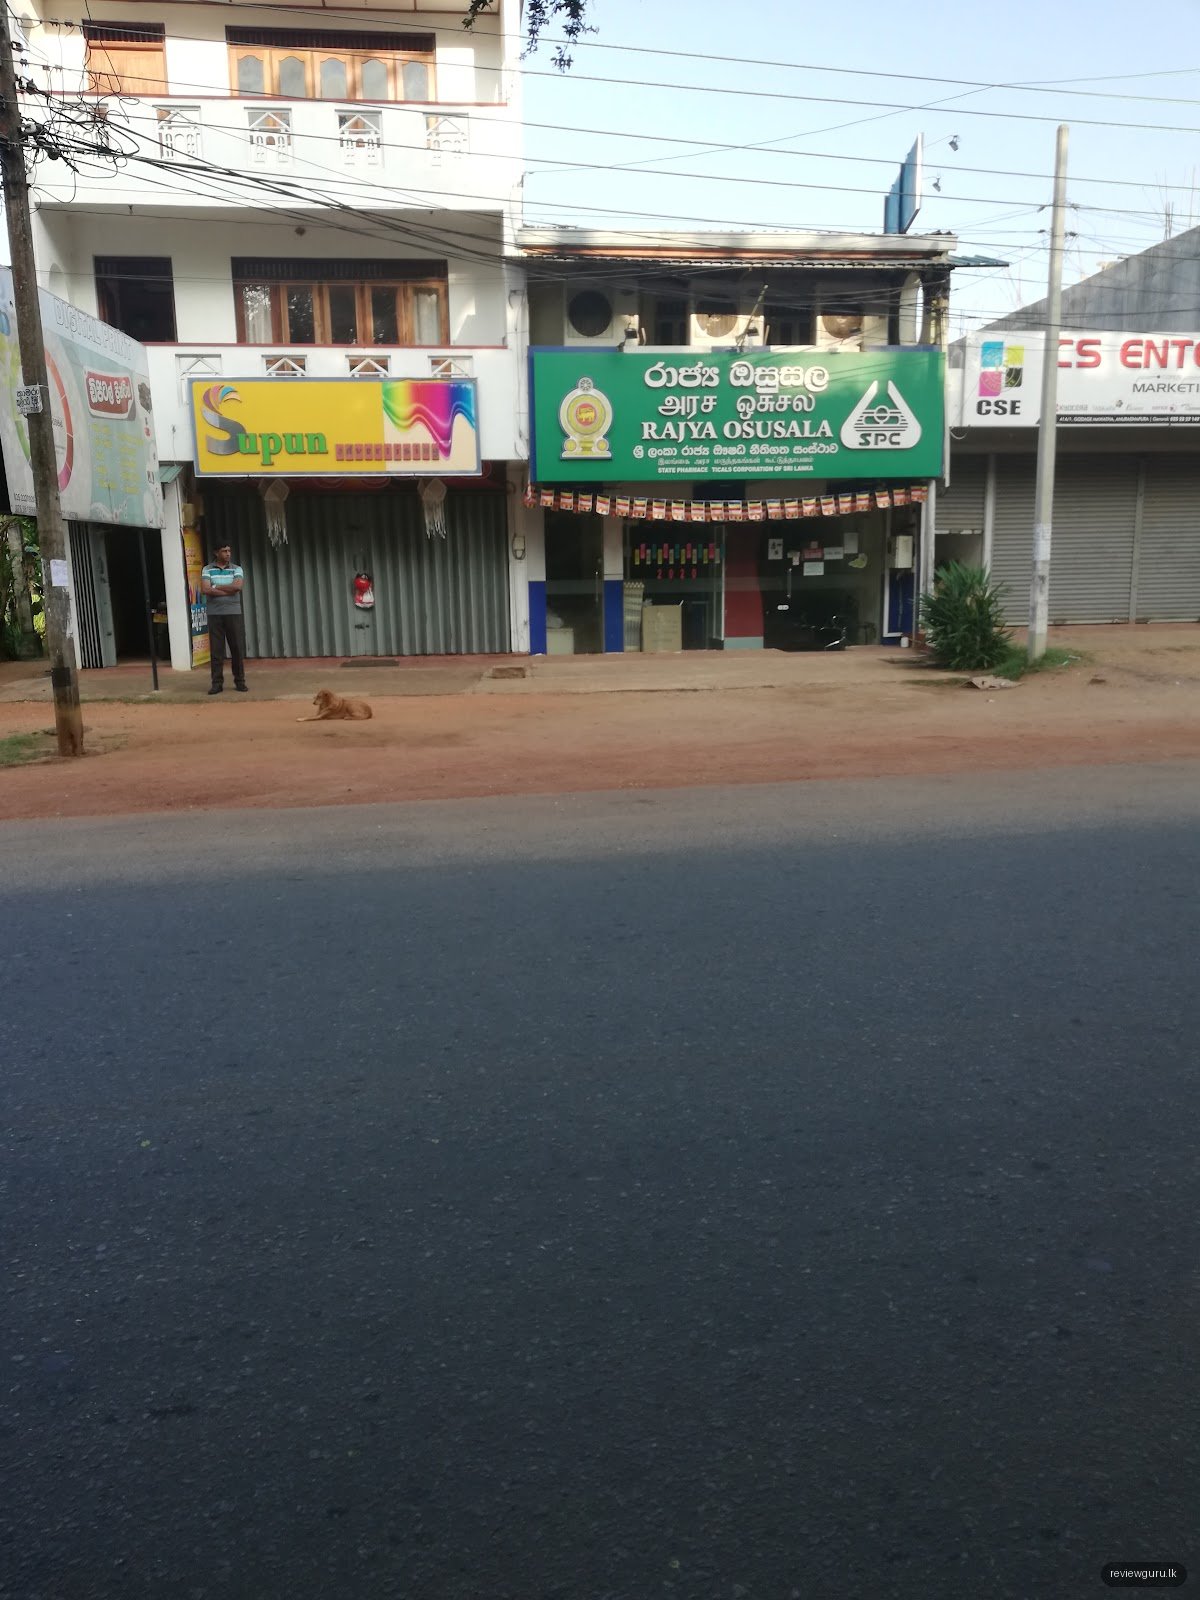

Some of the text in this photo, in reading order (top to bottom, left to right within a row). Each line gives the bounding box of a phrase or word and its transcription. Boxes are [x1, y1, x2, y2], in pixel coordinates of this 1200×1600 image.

[53, 297, 102, 347] DIGITAL
[1119, 339, 1200, 369] ENT
[644, 361, 830, 393] රාජ්‍ය ඔසුසල
[658, 395, 718, 420] அரச
[976, 400, 1022, 416] CSE
[201, 384, 329, 466] Supun
[641, 420, 834, 444] RAJYA OSUSALA
[858, 432, 901, 447] SPC
[648, 447, 678, 458] ලංකා
[733, 465, 774, 473] CORPORATION
